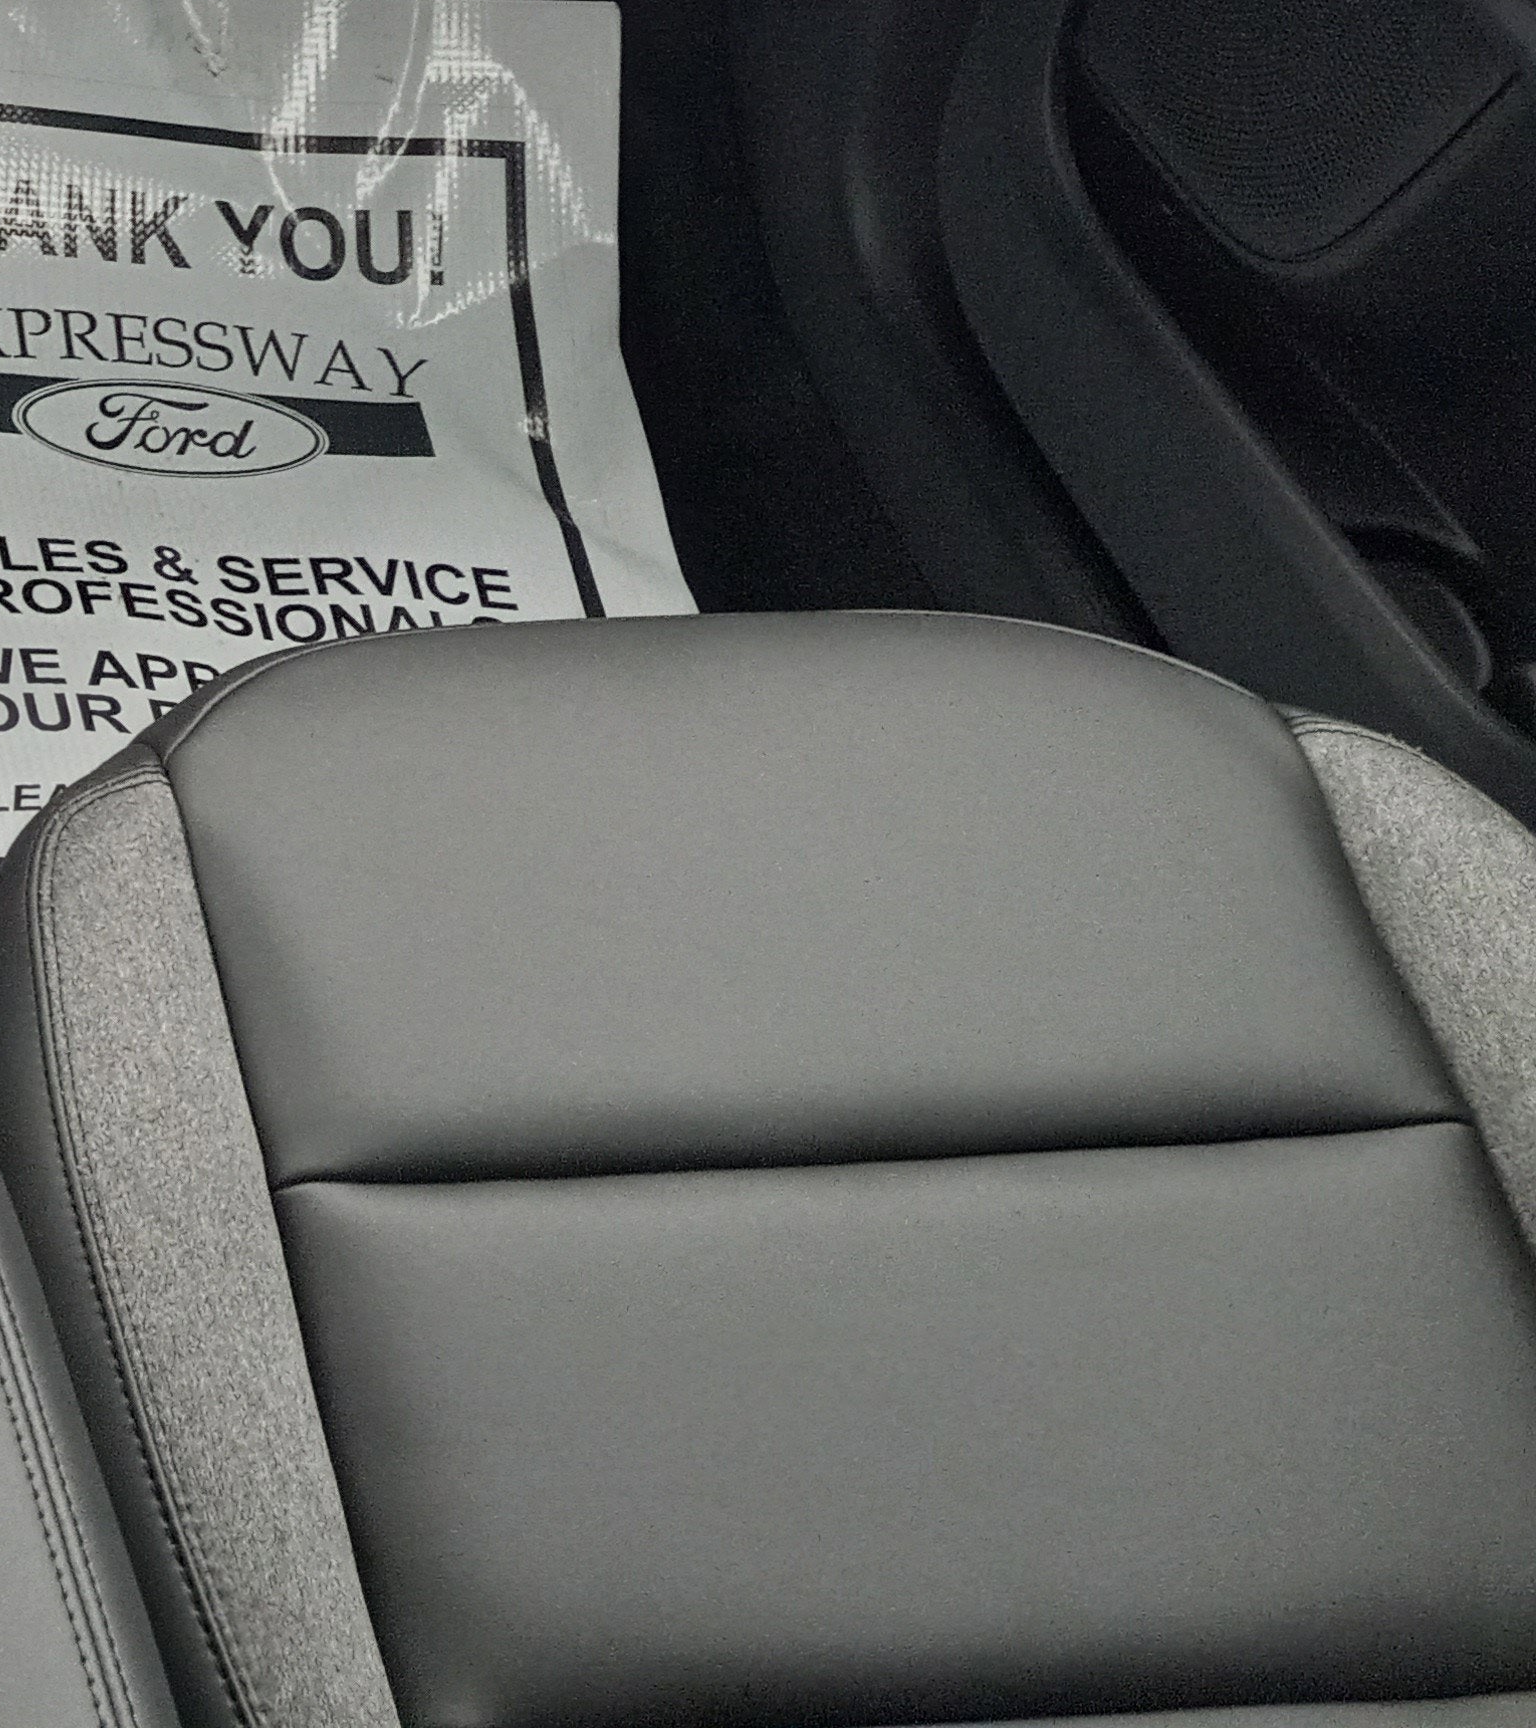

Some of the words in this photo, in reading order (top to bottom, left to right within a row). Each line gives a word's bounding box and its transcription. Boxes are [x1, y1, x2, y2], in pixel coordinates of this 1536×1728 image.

[215, 199, 445, 286] YOU!
[85, 391, 257, 462] Ford
[153, 544, 193, 585] &
[217, 555, 519, 611] SERVICE
